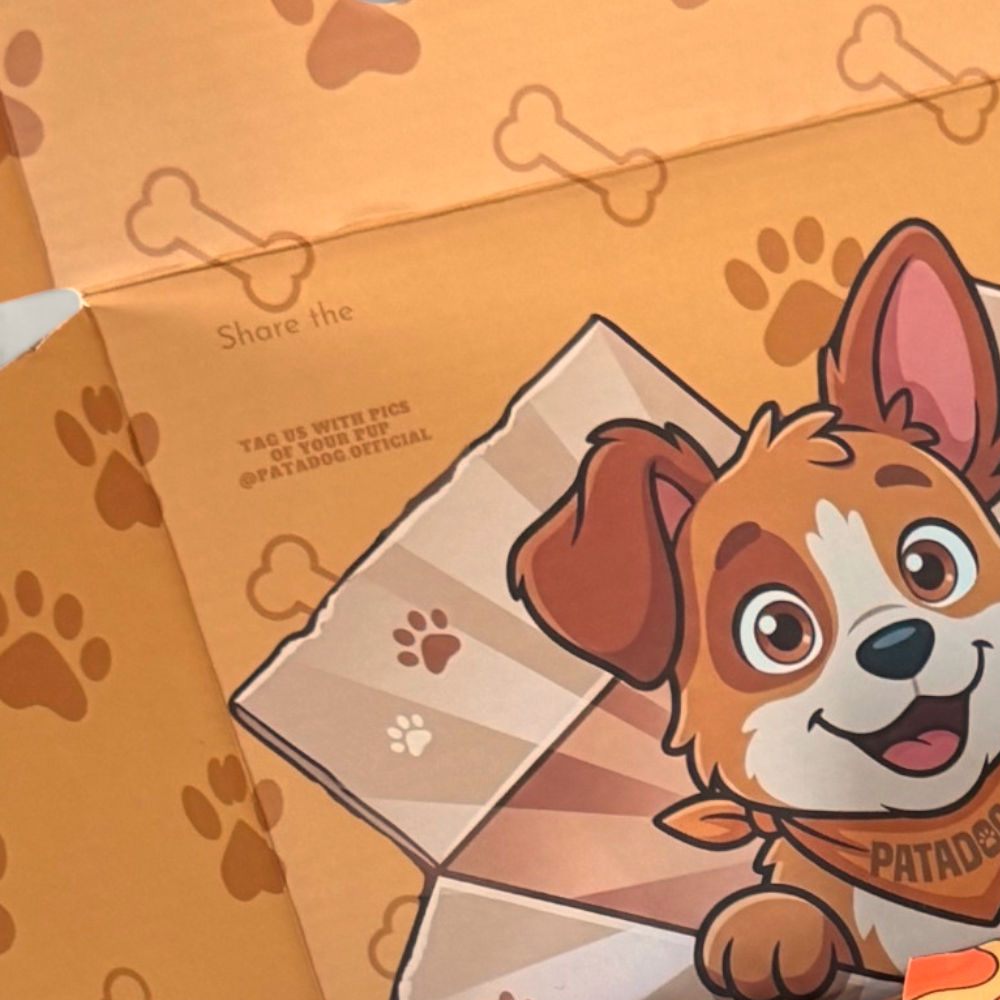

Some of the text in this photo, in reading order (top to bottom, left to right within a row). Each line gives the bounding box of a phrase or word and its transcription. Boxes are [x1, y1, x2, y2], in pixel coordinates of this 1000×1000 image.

[217, 301, 354, 350] Share the
[238, 400, 411, 453] TAG US WITH PICS
[270, 421, 390, 462] OF YOUR PUP
